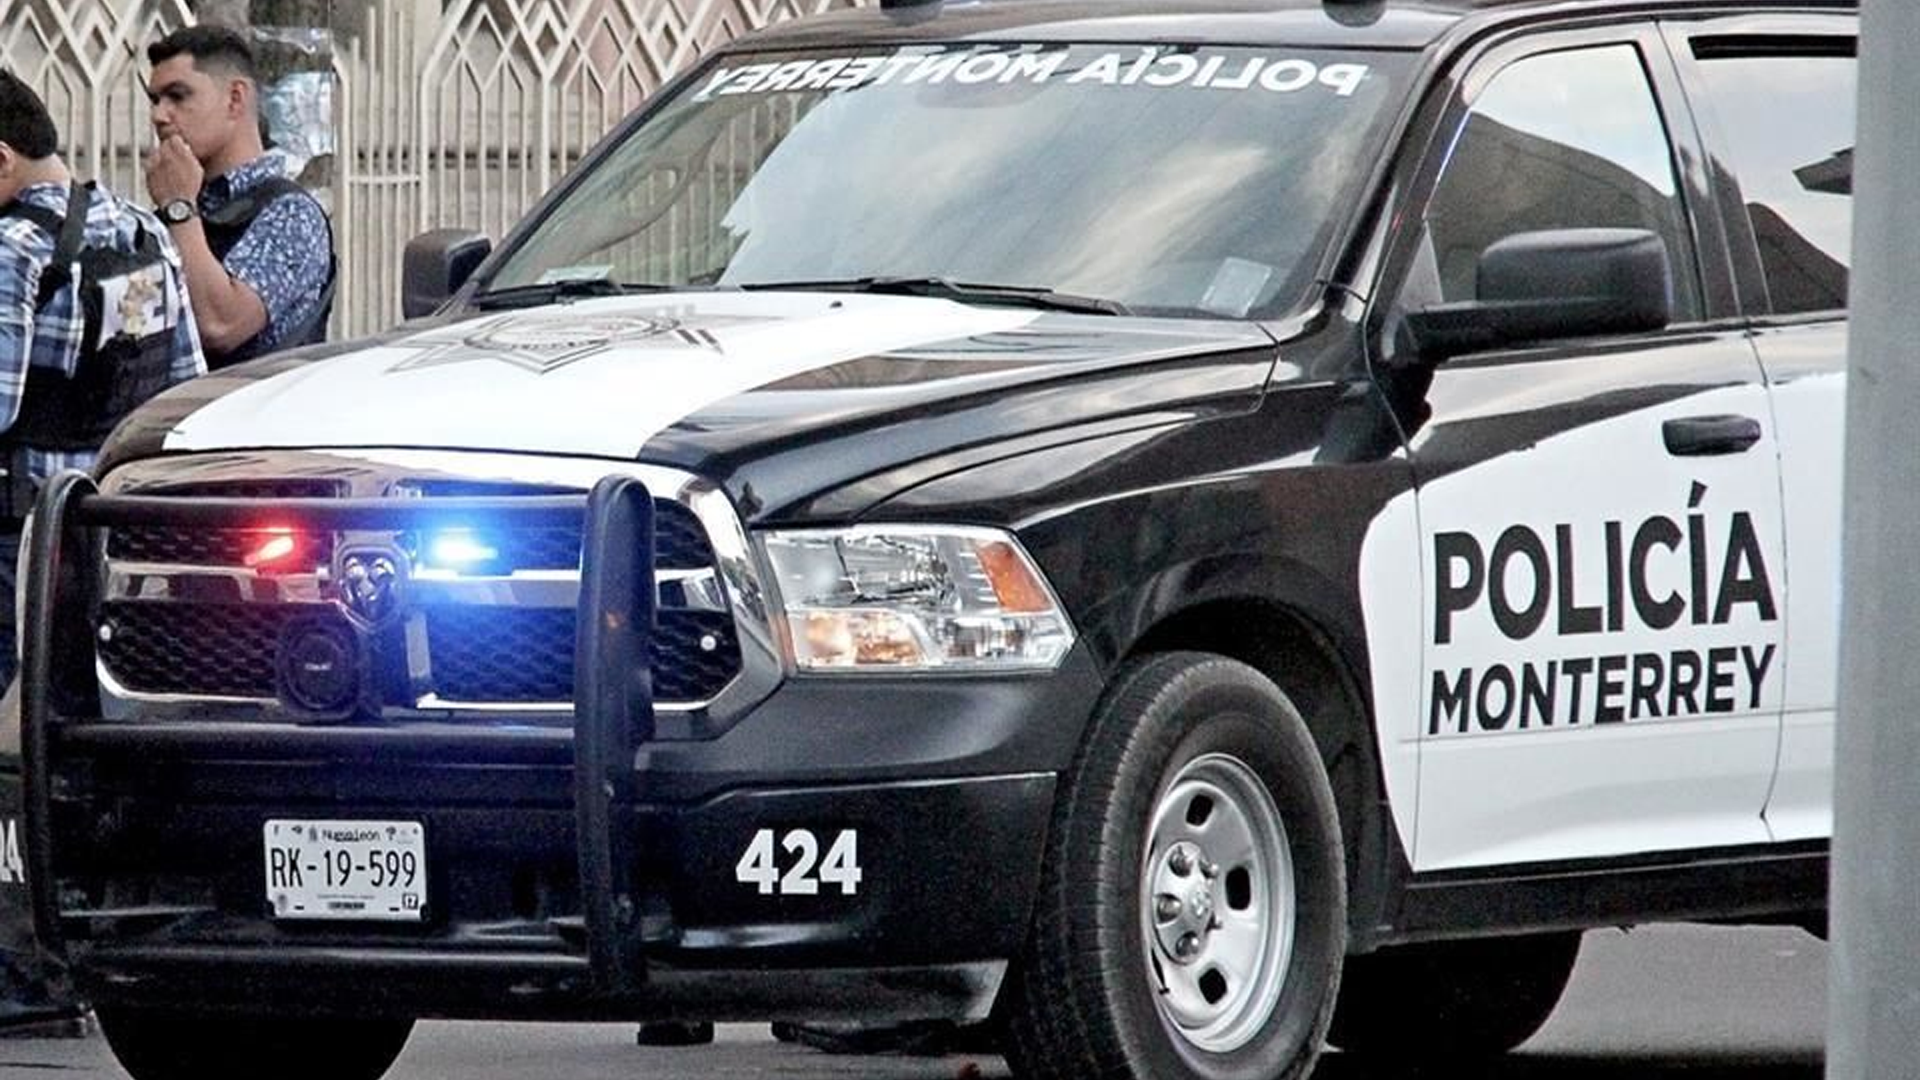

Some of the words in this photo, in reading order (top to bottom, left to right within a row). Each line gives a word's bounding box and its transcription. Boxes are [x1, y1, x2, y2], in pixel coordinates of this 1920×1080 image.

[1433, 479, 1778, 646] POLICÍA
[1428, 643, 1777, 735] MONTERREY
[270, 847, 416, 888] RK-19-599
[735, 828, 863, 894] 424
